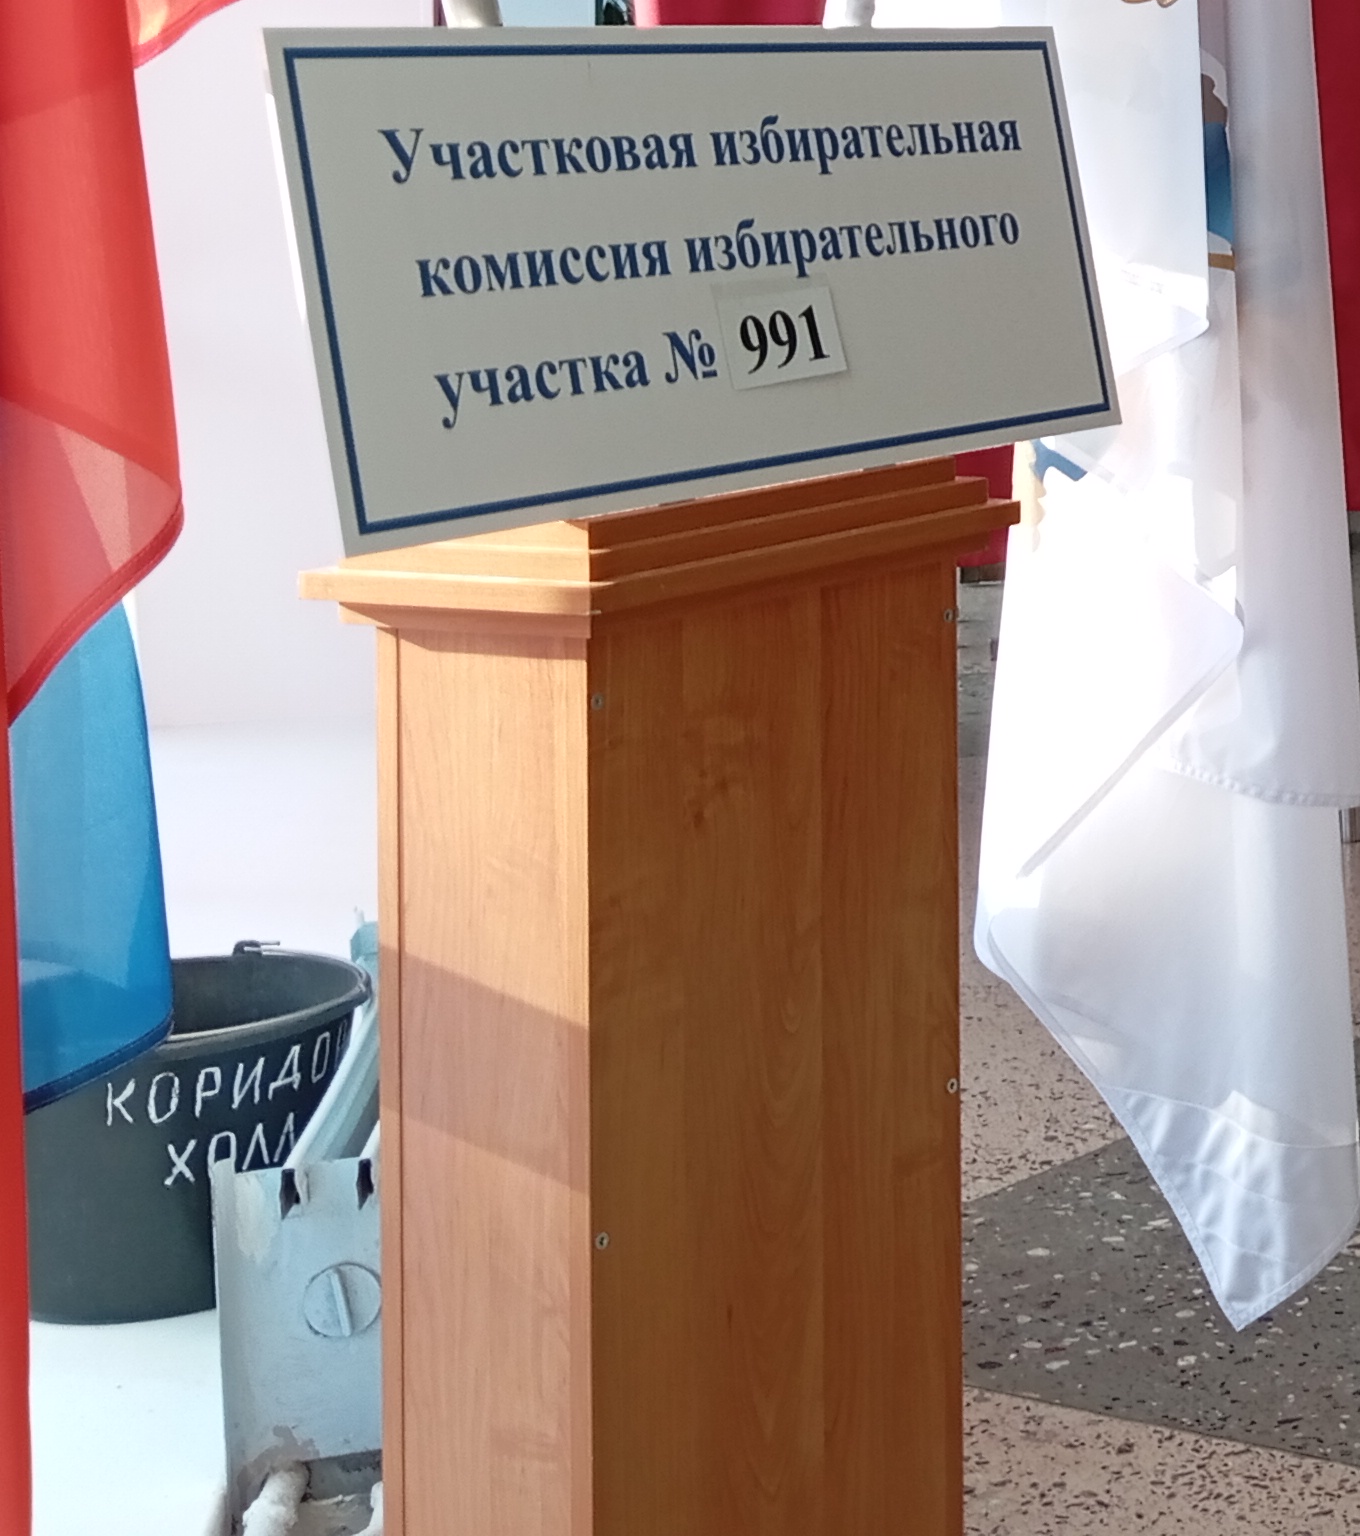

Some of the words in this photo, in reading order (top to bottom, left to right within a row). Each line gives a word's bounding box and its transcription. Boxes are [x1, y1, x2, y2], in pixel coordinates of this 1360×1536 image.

[378, 125, 698, 185] Участковая
[710, 114, 1023, 176] избирательная
[416, 235, 670, 298] комиссия
[686, 208, 1021, 279] избирательного
[433, 343, 650, 430] участка
[663, 326, 718, 385] №
[737, 302, 831, 375] 991
